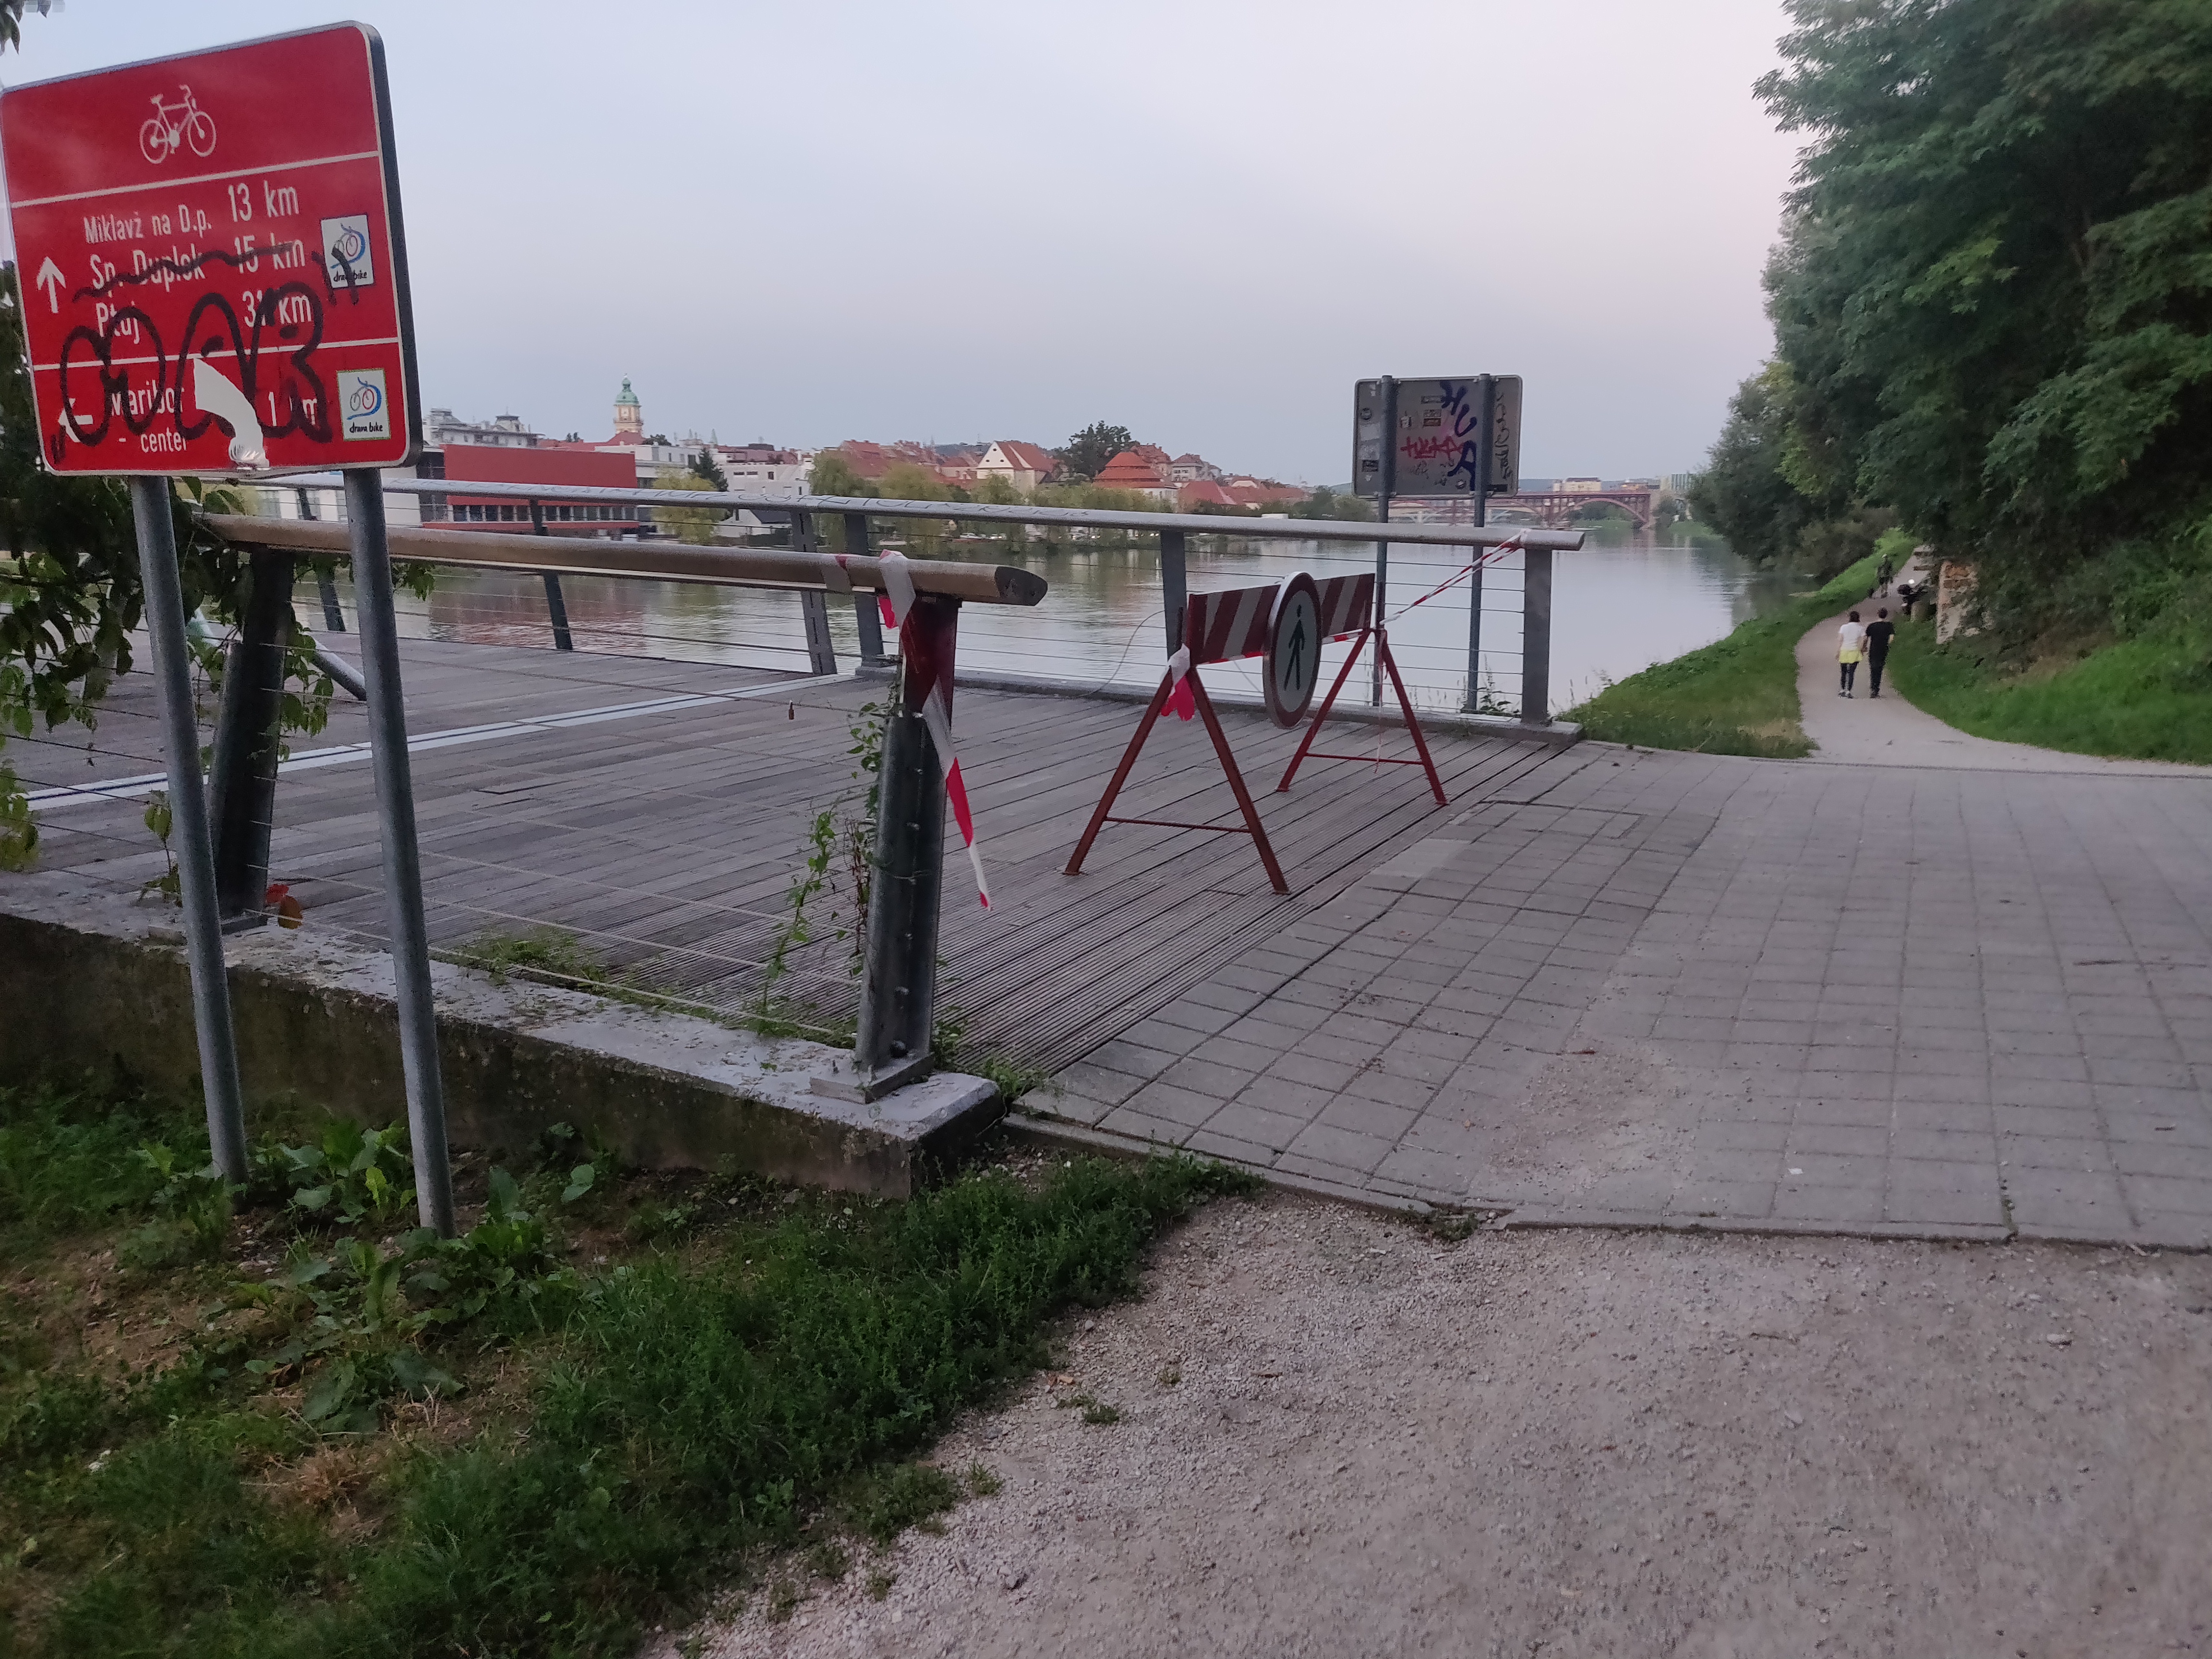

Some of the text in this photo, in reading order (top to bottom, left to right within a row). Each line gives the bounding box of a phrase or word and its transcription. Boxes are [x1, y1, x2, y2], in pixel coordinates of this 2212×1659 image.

[152, 214, 171, 236] na
[178, 204, 212, 238] D.p.
[228, 183, 252, 222] 13
[264, 180, 300, 217] km
[234, 235, 258, 274] 15
[271, 232, 305, 270] km
[333, 270, 351, 282] dra
[96, 300, 140, 344] Ptuj
[278, 289, 312, 325] km
[140, 426, 187, 453] center
[349, 421, 383, 433] drava bike
